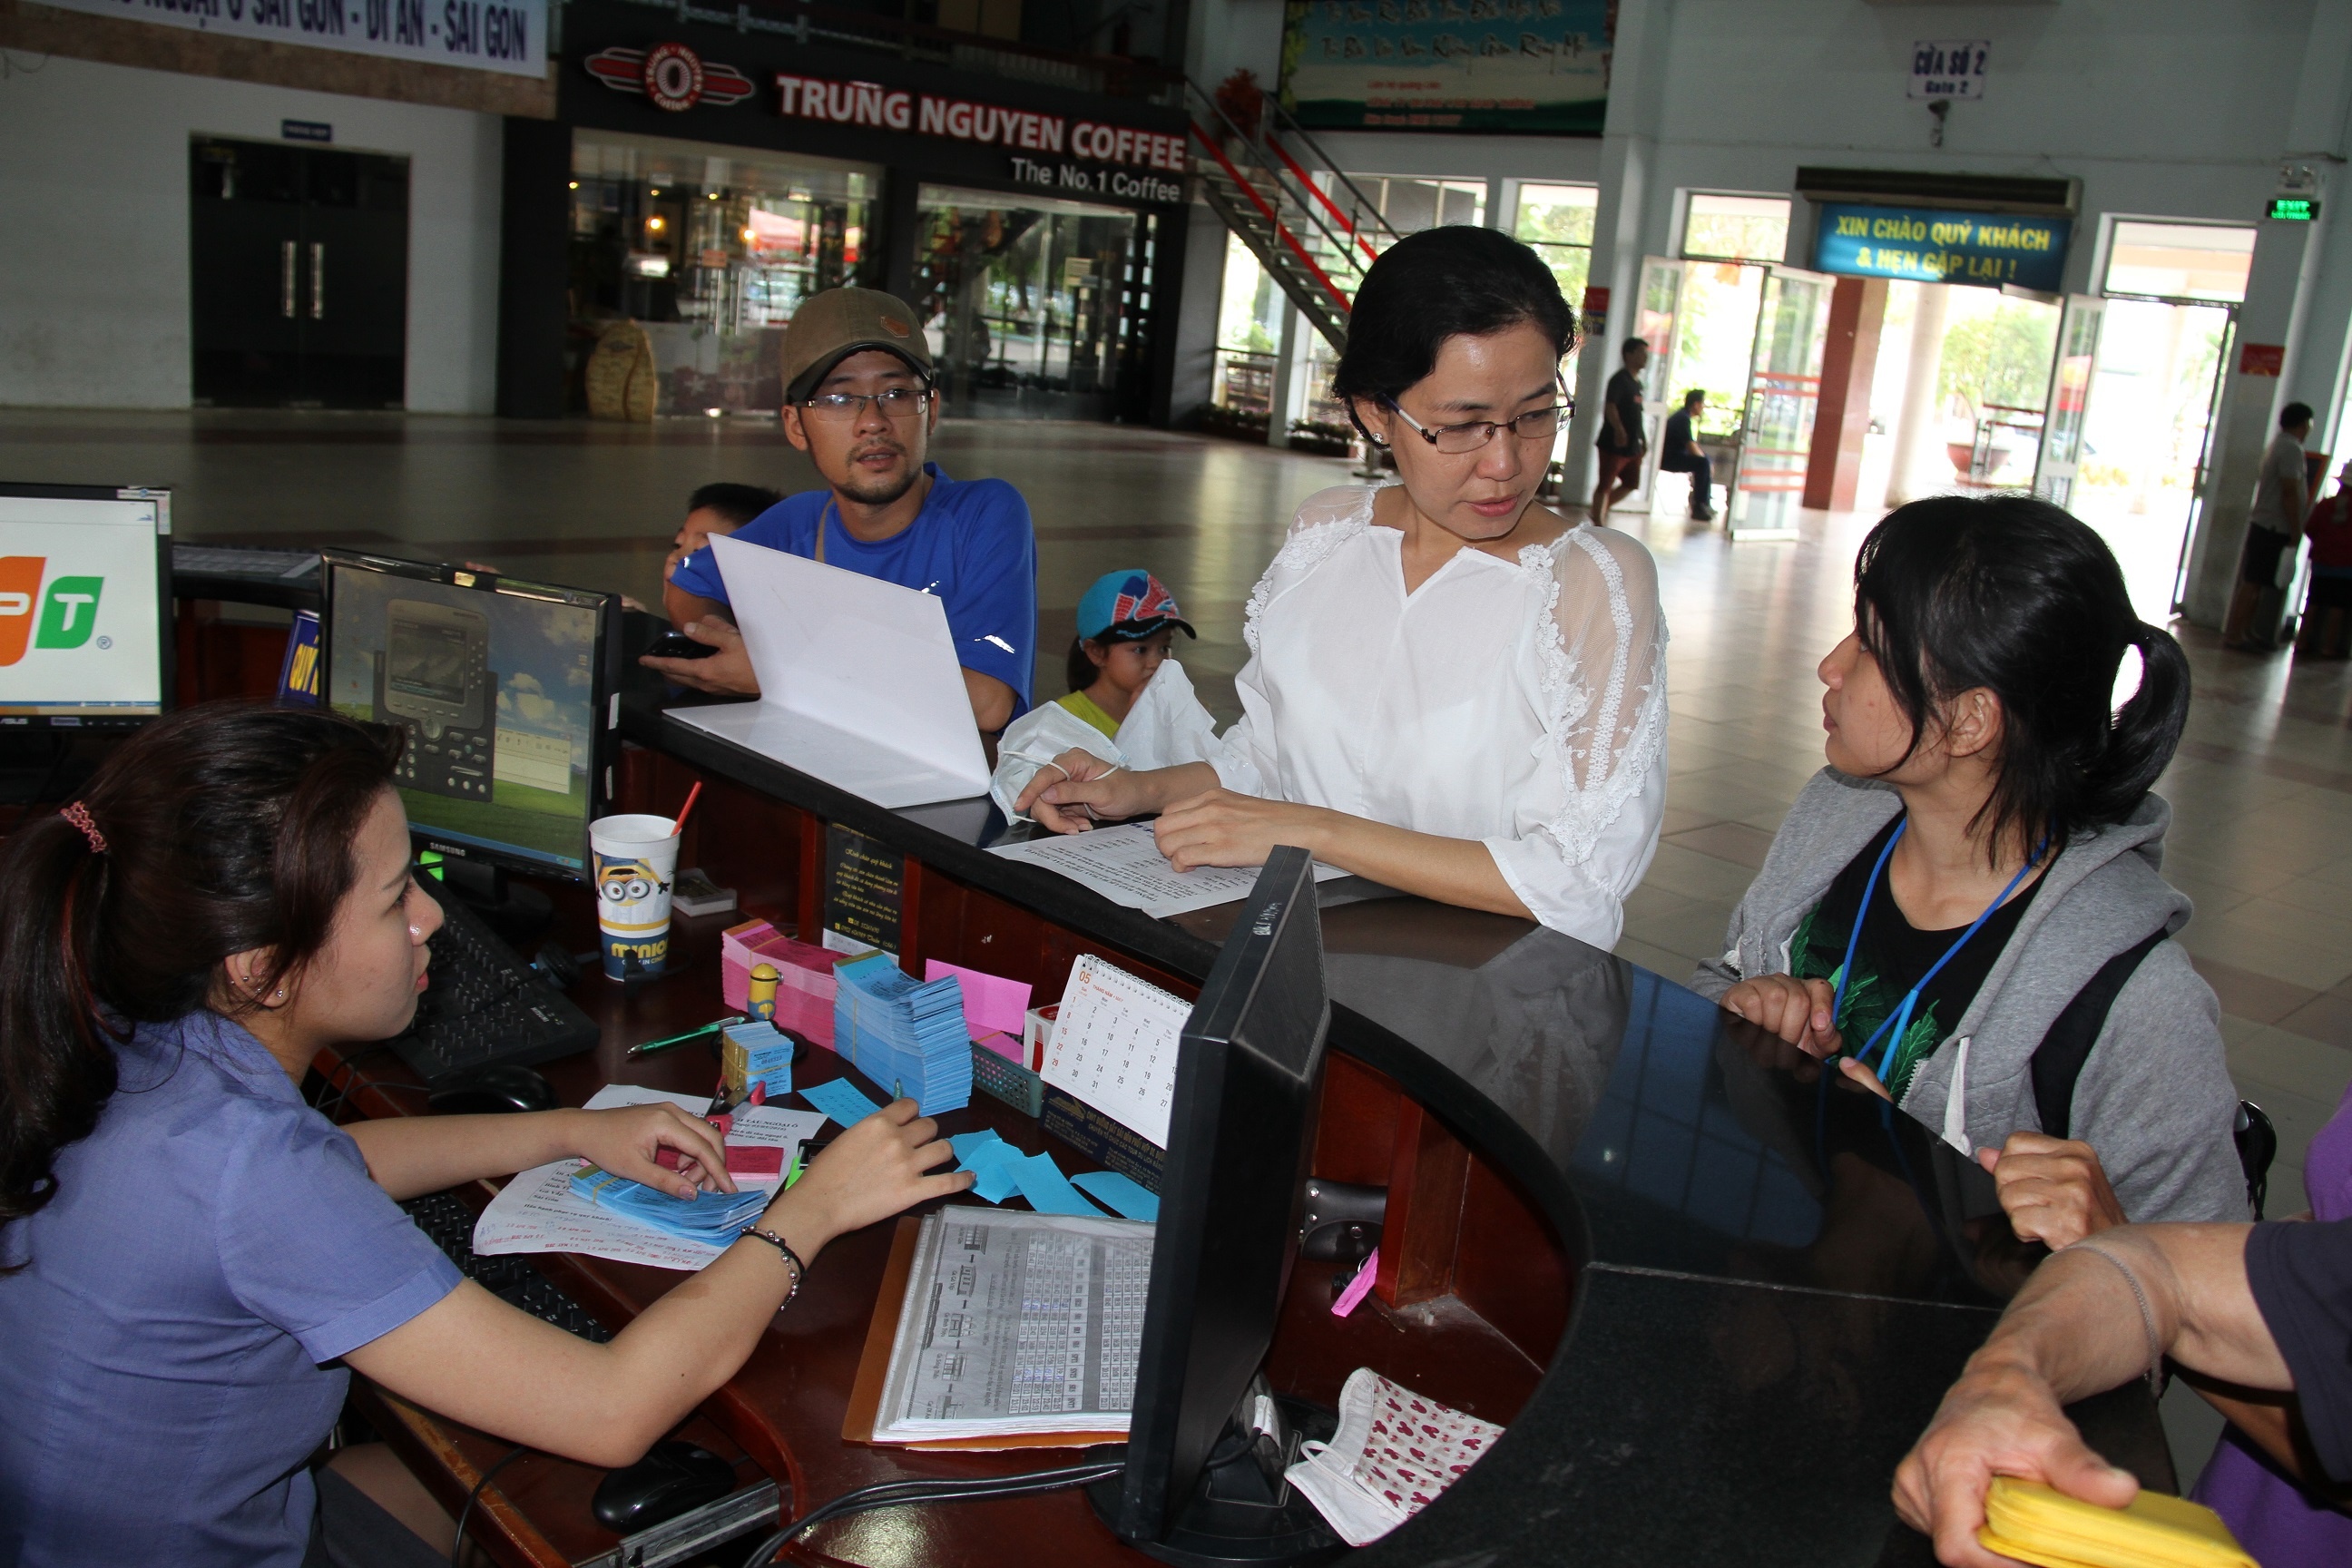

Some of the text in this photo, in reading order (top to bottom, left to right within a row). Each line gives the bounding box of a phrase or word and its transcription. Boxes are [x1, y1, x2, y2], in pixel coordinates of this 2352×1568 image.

[1974, 49, 1986, 75] 2
[1960, 80, 1969, 94] 2
[777, 74, 1187, 171] TRUNG NGUYEN COFFEE
[1012, 157, 1181, 202] The No.1 Coffee
[1836, 215, 1869, 238] XIN
[1873, 214, 1926, 242] CHÀO
[1977, 221, 2051, 251] KHÁCH
[1877, 248, 1918, 275] HẸN
[1968, 257, 2003, 281] LẠI
[430, 841, 466, 857] SAMSUNG
[1079, 970, 1091, 984] 05
[1066, 1011, 1072, 1019] 8
[1087, 1022, 1092, 1030] 9
[1107, 1033, 1114, 1041] 10
[1128, 1044, 1134, 1052] 11
[1149, 1054, 1156, 1063] 12
[1113, 1016, 1118, 1024] 3
[1155, 1038, 1160, 1046] 5
[1052, 1058, 1099, 1089] 29 30 31
[1056, 1043, 1168, 1108] 22 23 24 25 26 27
[1062, 1026, 1173, 1092] 15 16 17 18 19 20
